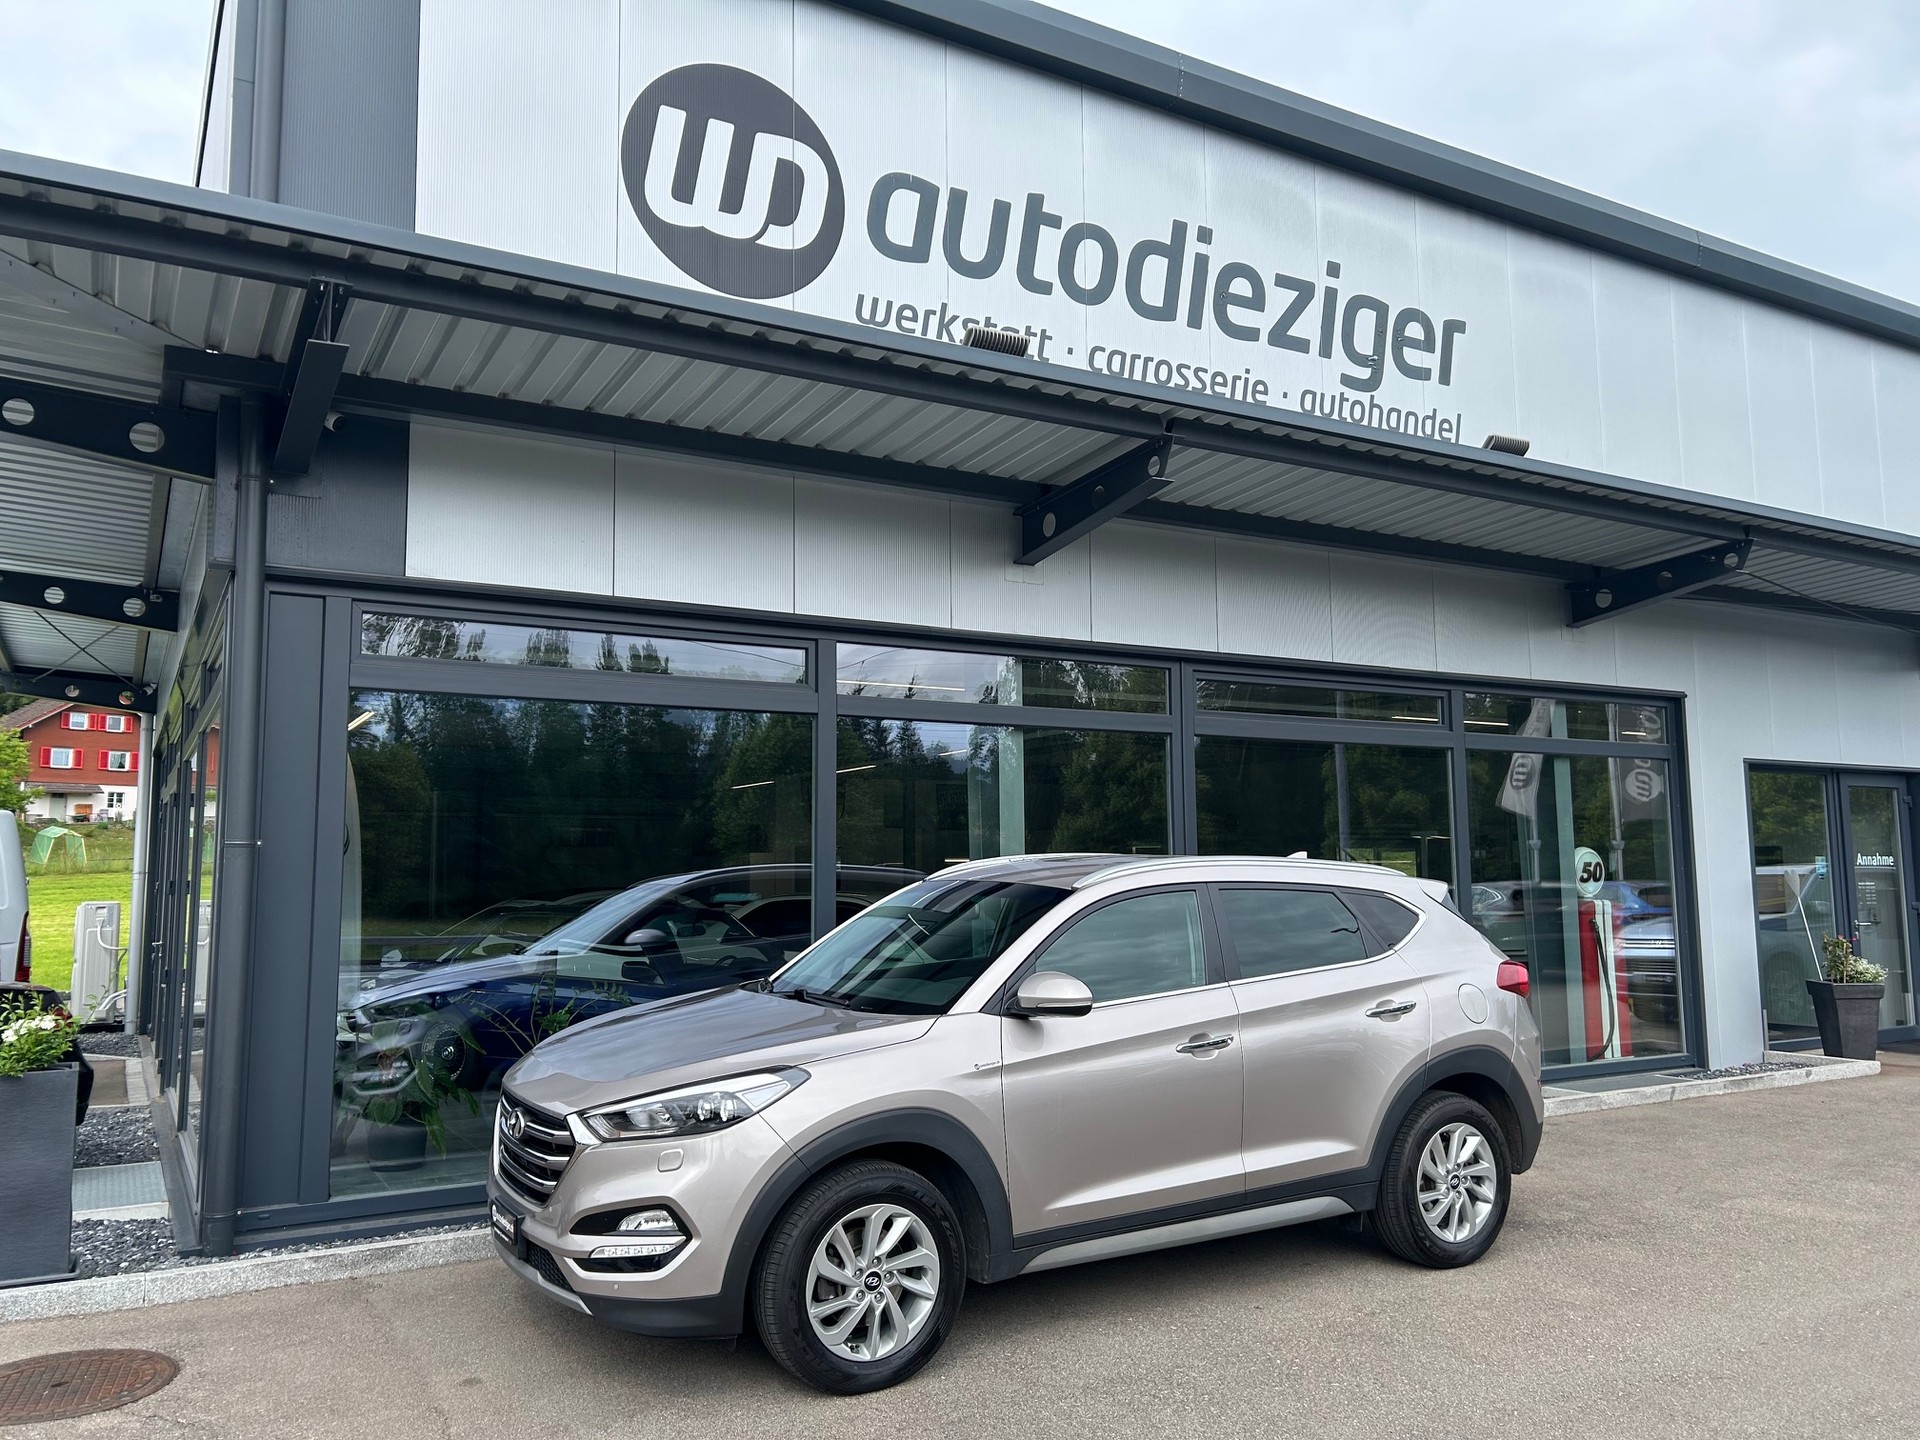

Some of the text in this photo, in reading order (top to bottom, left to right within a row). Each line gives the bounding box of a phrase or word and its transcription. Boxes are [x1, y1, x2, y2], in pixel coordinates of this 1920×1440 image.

[866, 171, 1467, 393] autodieziger
[855, 293, 1462, 444] werktt carrosserie autohandel
[1579, 861, 1603, 883] 50
[1856, 852, 1895, 866] Annahme
